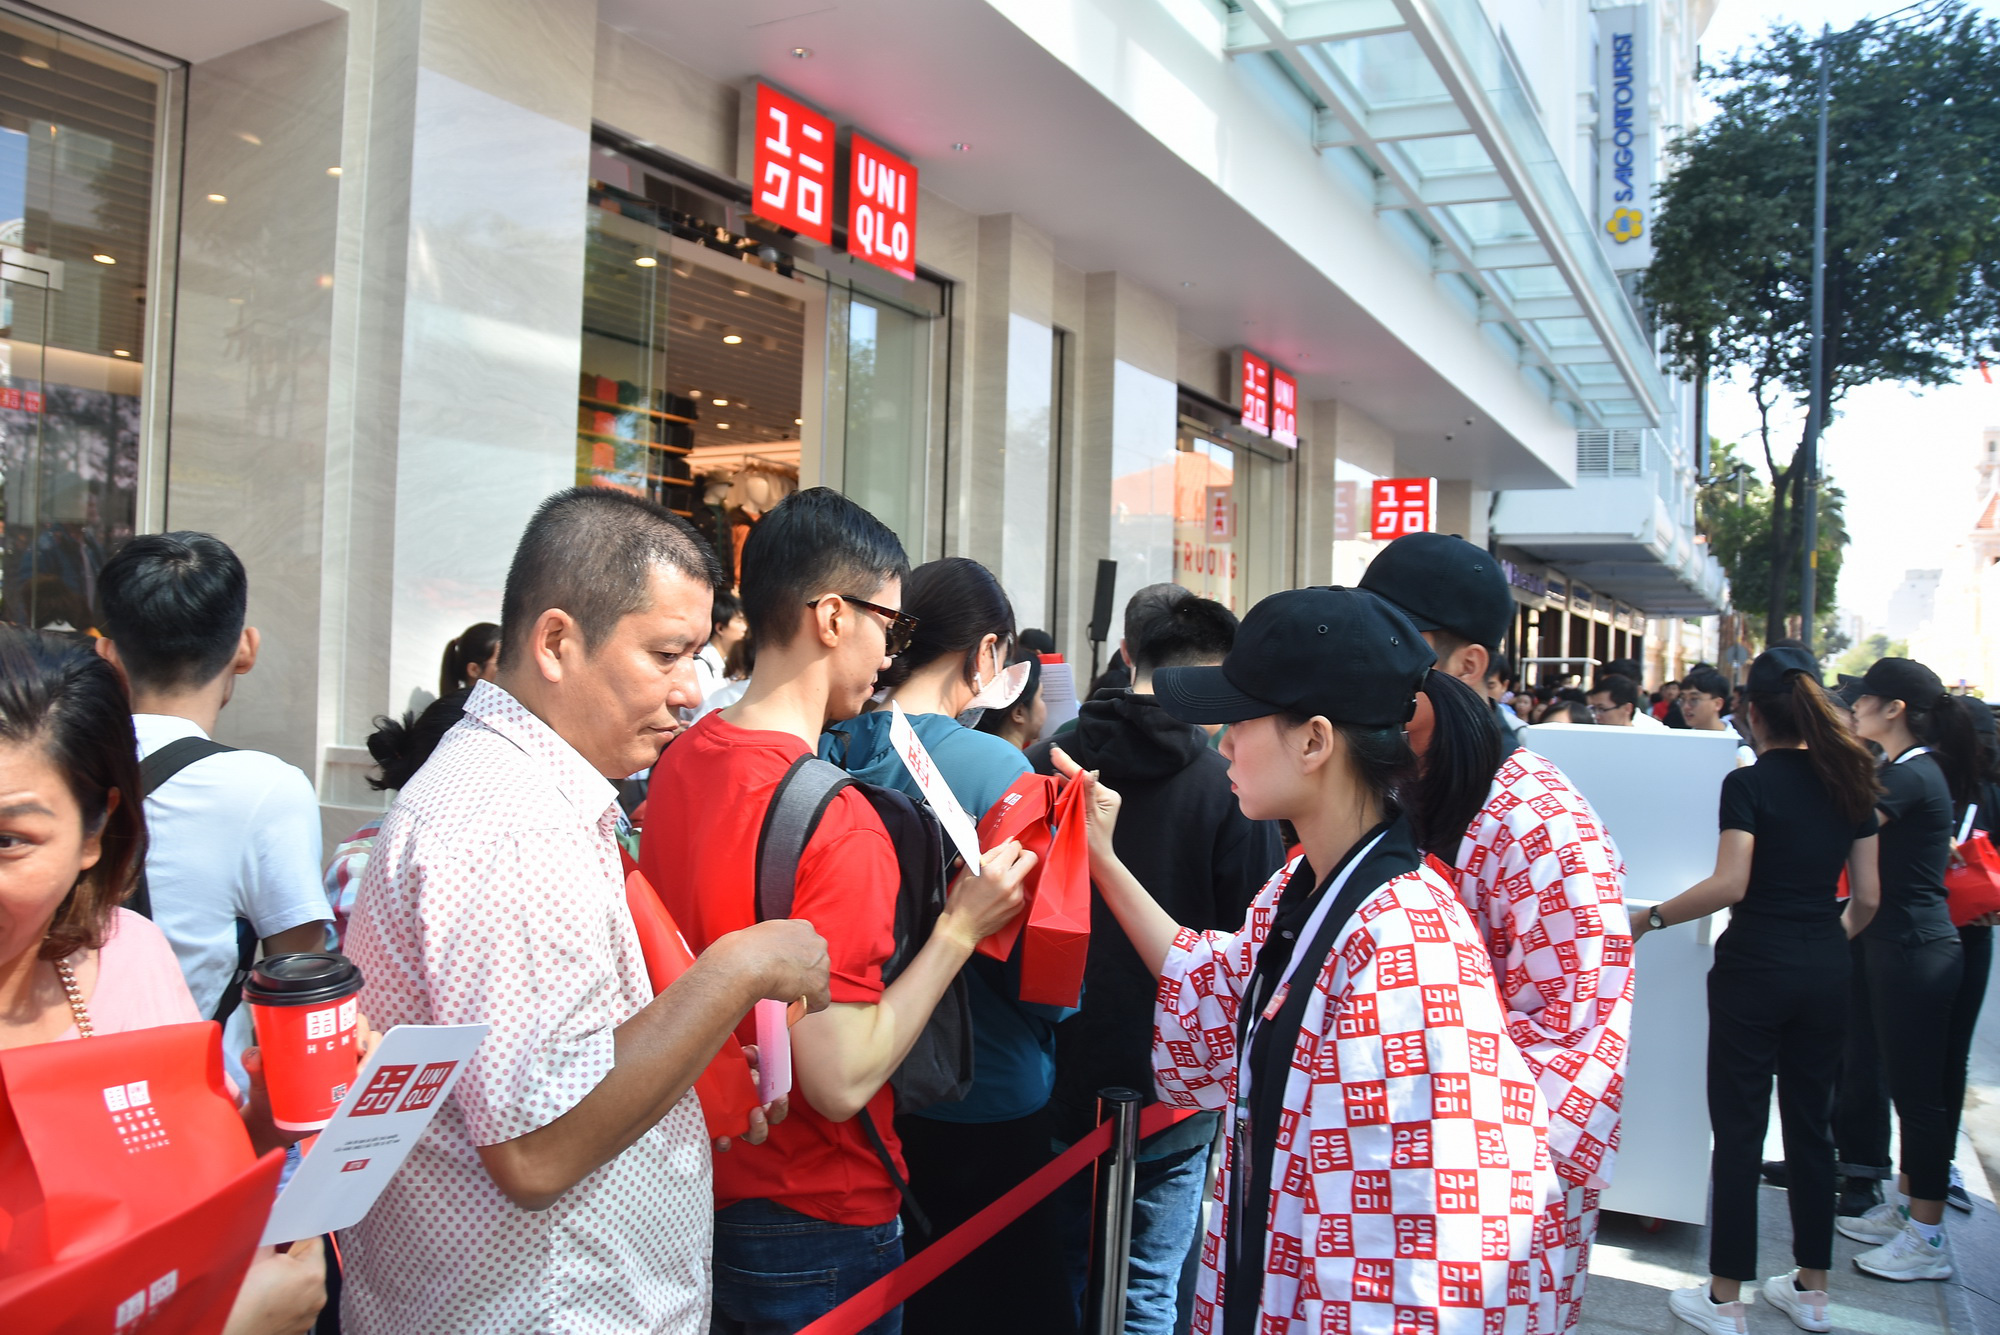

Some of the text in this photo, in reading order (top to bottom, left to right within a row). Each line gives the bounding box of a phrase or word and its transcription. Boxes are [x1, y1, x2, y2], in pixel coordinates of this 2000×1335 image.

[1613, 32, 1634, 202] SAIGONTOURIST
[857, 152, 907, 215] UNI
[855, 204, 909, 262] QLO
[1274, 377, 1294, 409] UNI
[1378, 485, 1425, 508] ユニ
[1375, 511, 1425, 533] クロ
[1530, 800, 1549, 817] QLO
[1542, 794, 1563, 812] UNI
[1586, 907, 1601, 931] UNI
[1377, 950, 1397, 987] QLO
[1395, 948, 1415, 981] UNI
[1426, 989, 1445, 1023] クロ
[1443, 988, 1462, 1021] ユニ
[1385, 1037, 1406, 1074] QLO
[1404, 1034, 1425, 1069] UNI
[1468, 1037, 1482, 1070] UNI
[1480, 1036, 1498, 1073] QLO
[1596, 1034, 1613, 1059] UNI
[371, 1070, 408, 1090] ユニ
[418, 1066, 450, 1086] UNI
[355, 1091, 395, 1111] クロ
[404, 1087, 436, 1110] QLO
[1365, 1086, 1384, 1117] ユニ
[1434, 1077, 1453, 1112] クロ
[1451, 1077, 1468, 1111] ユニ
[1561, 1092, 1580, 1117] UNI
[1574, 1097, 1594, 1123] QLO
[1311, 1136, 1331, 1169] QLO
[1329, 1134, 1349, 1165] UNI
[1394, 1130, 1412, 1165] QLO
[1412, 1128, 1429, 1161] UNI
[1477, 1131, 1493, 1165] UNI
[1492, 1128, 1509, 1165] QLO
[1355, 1175, 1372, 1208] クロ
[1372, 1175, 1388, 1208] ユニ
[1439, 1173, 1458, 1209] クロ
[1458, 1173, 1477, 1208] ユニ
[1318, 1219, 1334, 1253] QLO
[1333, 1218, 1350, 1250] UNI
[1397, 1219, 1415, 1255] QLO
[1417, 1219, 1433, 1252] UNI
[1482, 1222, 1496, 1256] UNI
[1495, 1219, 1509, 1256] QLO
[1376, 1263, 1391, 1297] ユニ
[1462, 1266, 1480, 1300] ユニ
